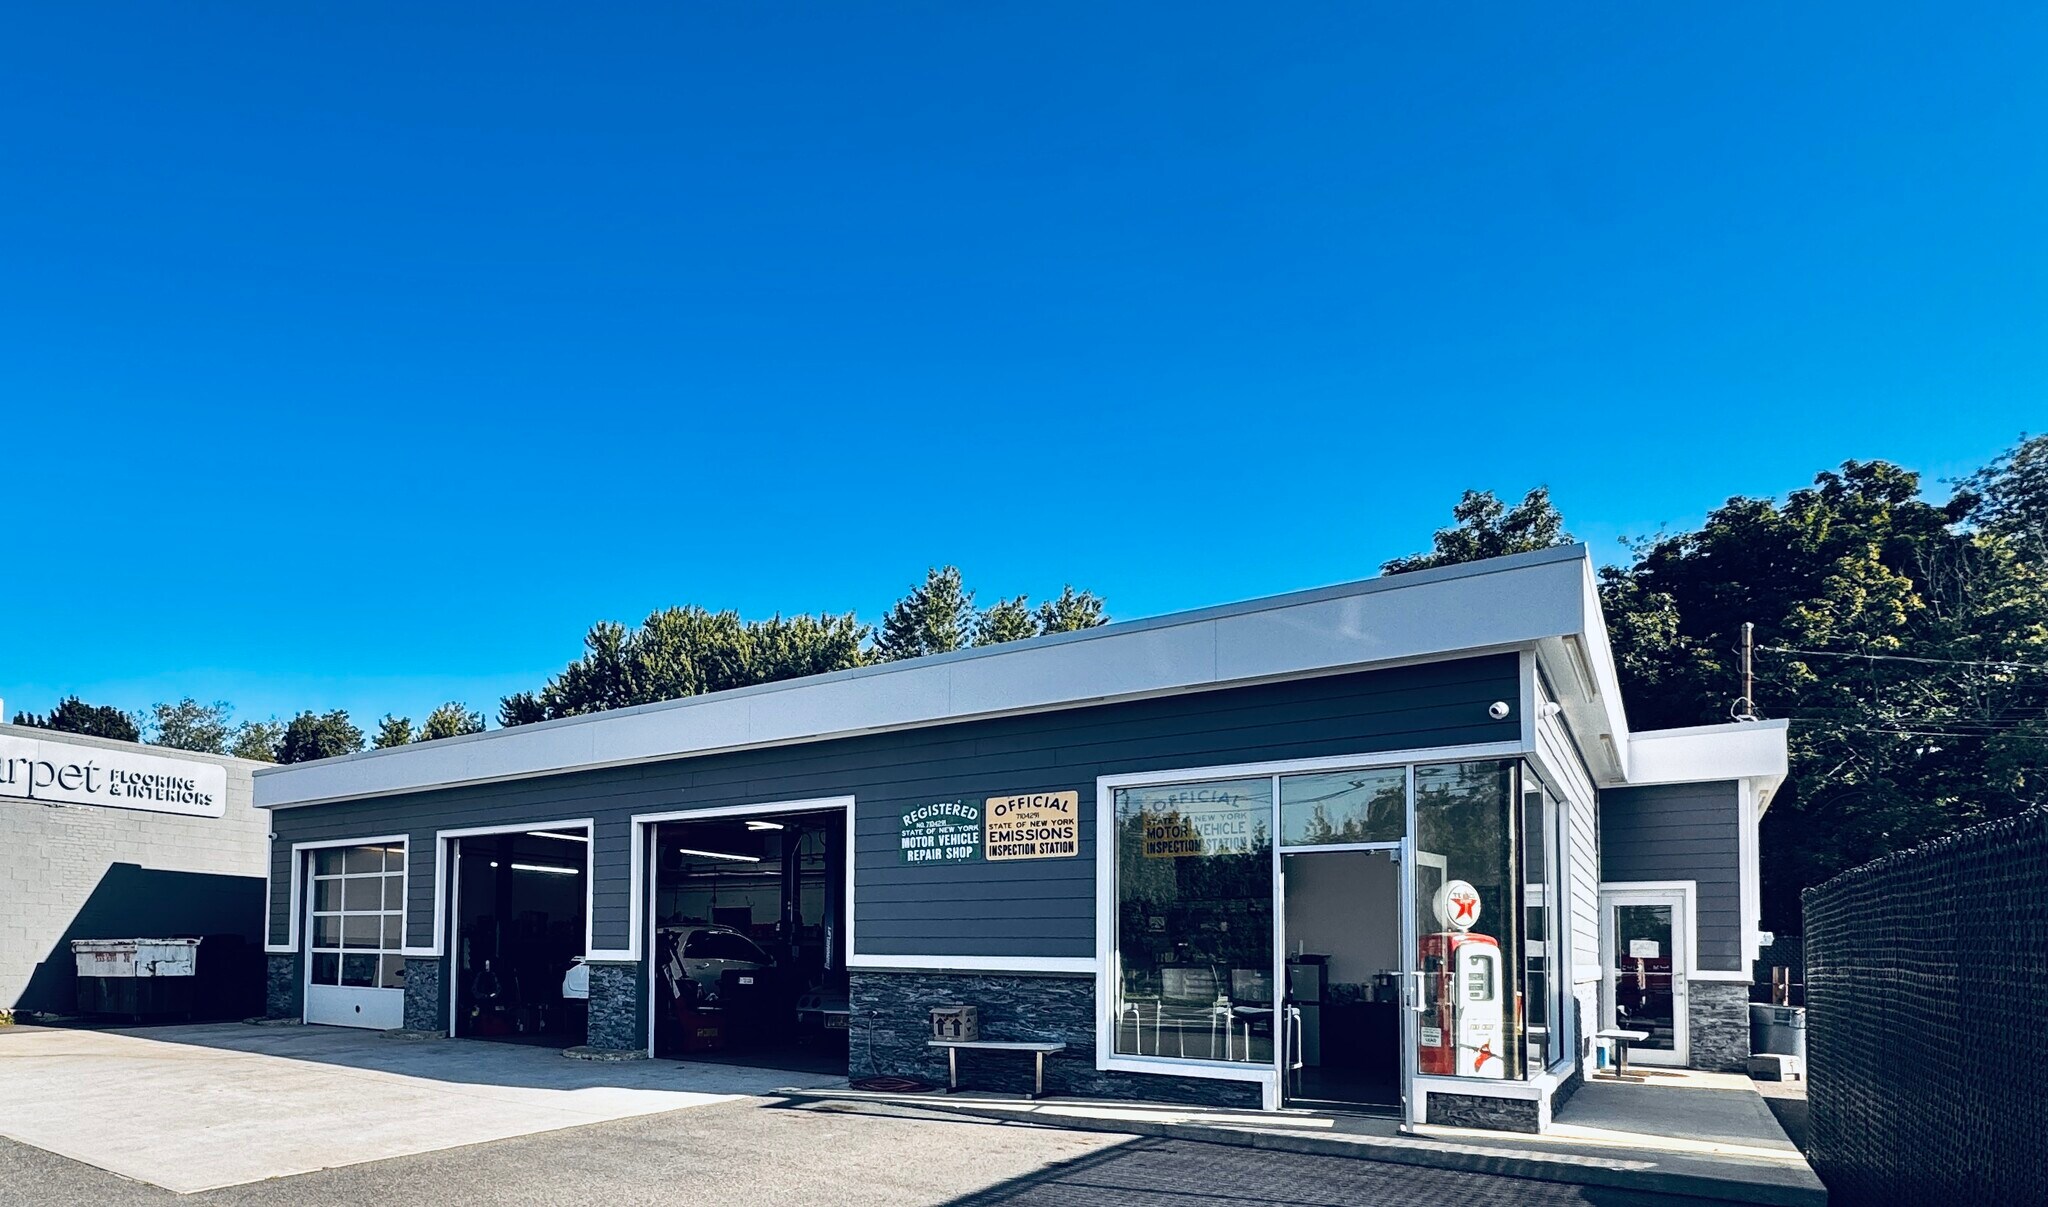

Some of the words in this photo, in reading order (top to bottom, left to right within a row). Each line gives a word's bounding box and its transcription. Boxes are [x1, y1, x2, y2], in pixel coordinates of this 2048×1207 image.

[110, 769, 195, 791] FLOORING
[110, 783, 121, 796] &
[127, 784, 213, 806] INTERIORS
[1152, 790, 1240, 812] OFFICIAL
[994, 796, 1068, 816] OFFICIAL
[902, 803, 978, 827] REGISTERED
[1194, 814, 1215, 822] NEW
[1220, 812, 1247, 820] YORK
[901, 829, 924, 837] STATE
[958, 824, 979, 832] YORK
[988, 822, 1012, 830] STATE
[1051, 818, 1074, 826] YORK
[1146, 825, 1188, 839] MOTOR
[1194, 821, 1246, 837] VEHICLE
[901, 836, 935, 849] MOTOR
[938, 833, 979, 847] VEHICLE
[989, 827, 1073, 843] EMISSIONS
[989, 843, 1036, 857] INSPECTION
[1039, 841, 1074, 854] STATION
[1146, 839, 1201, 854] INSPECTION
[1206, 836, 1247, 851] STATION
[907, 848, 942, 862] REPAIR
[946, 846, 973, 859] SHOP
